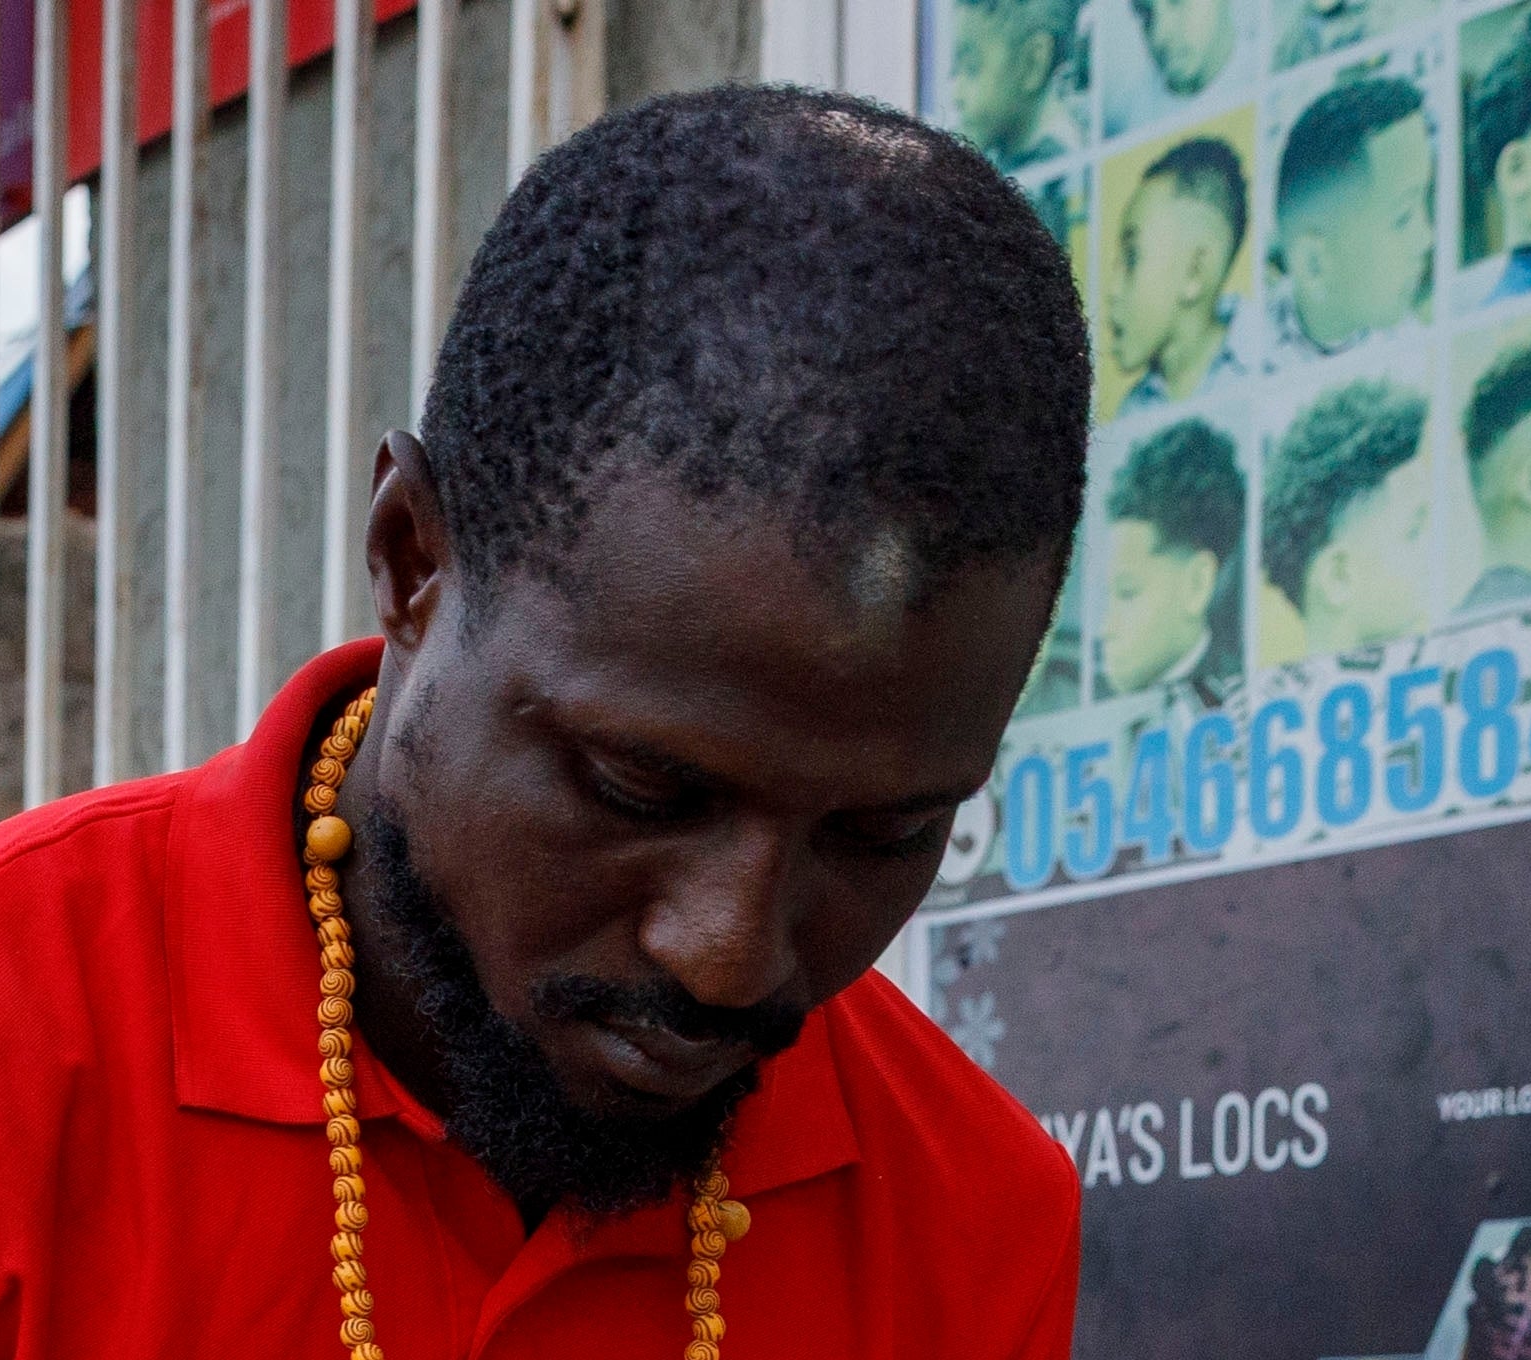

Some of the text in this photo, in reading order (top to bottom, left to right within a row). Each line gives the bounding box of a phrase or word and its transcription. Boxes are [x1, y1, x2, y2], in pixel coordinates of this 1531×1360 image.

[1043, 1082, 1330, 1188] YA'S LOCS
[1438, 1087, 1503, 1122] YOUR
